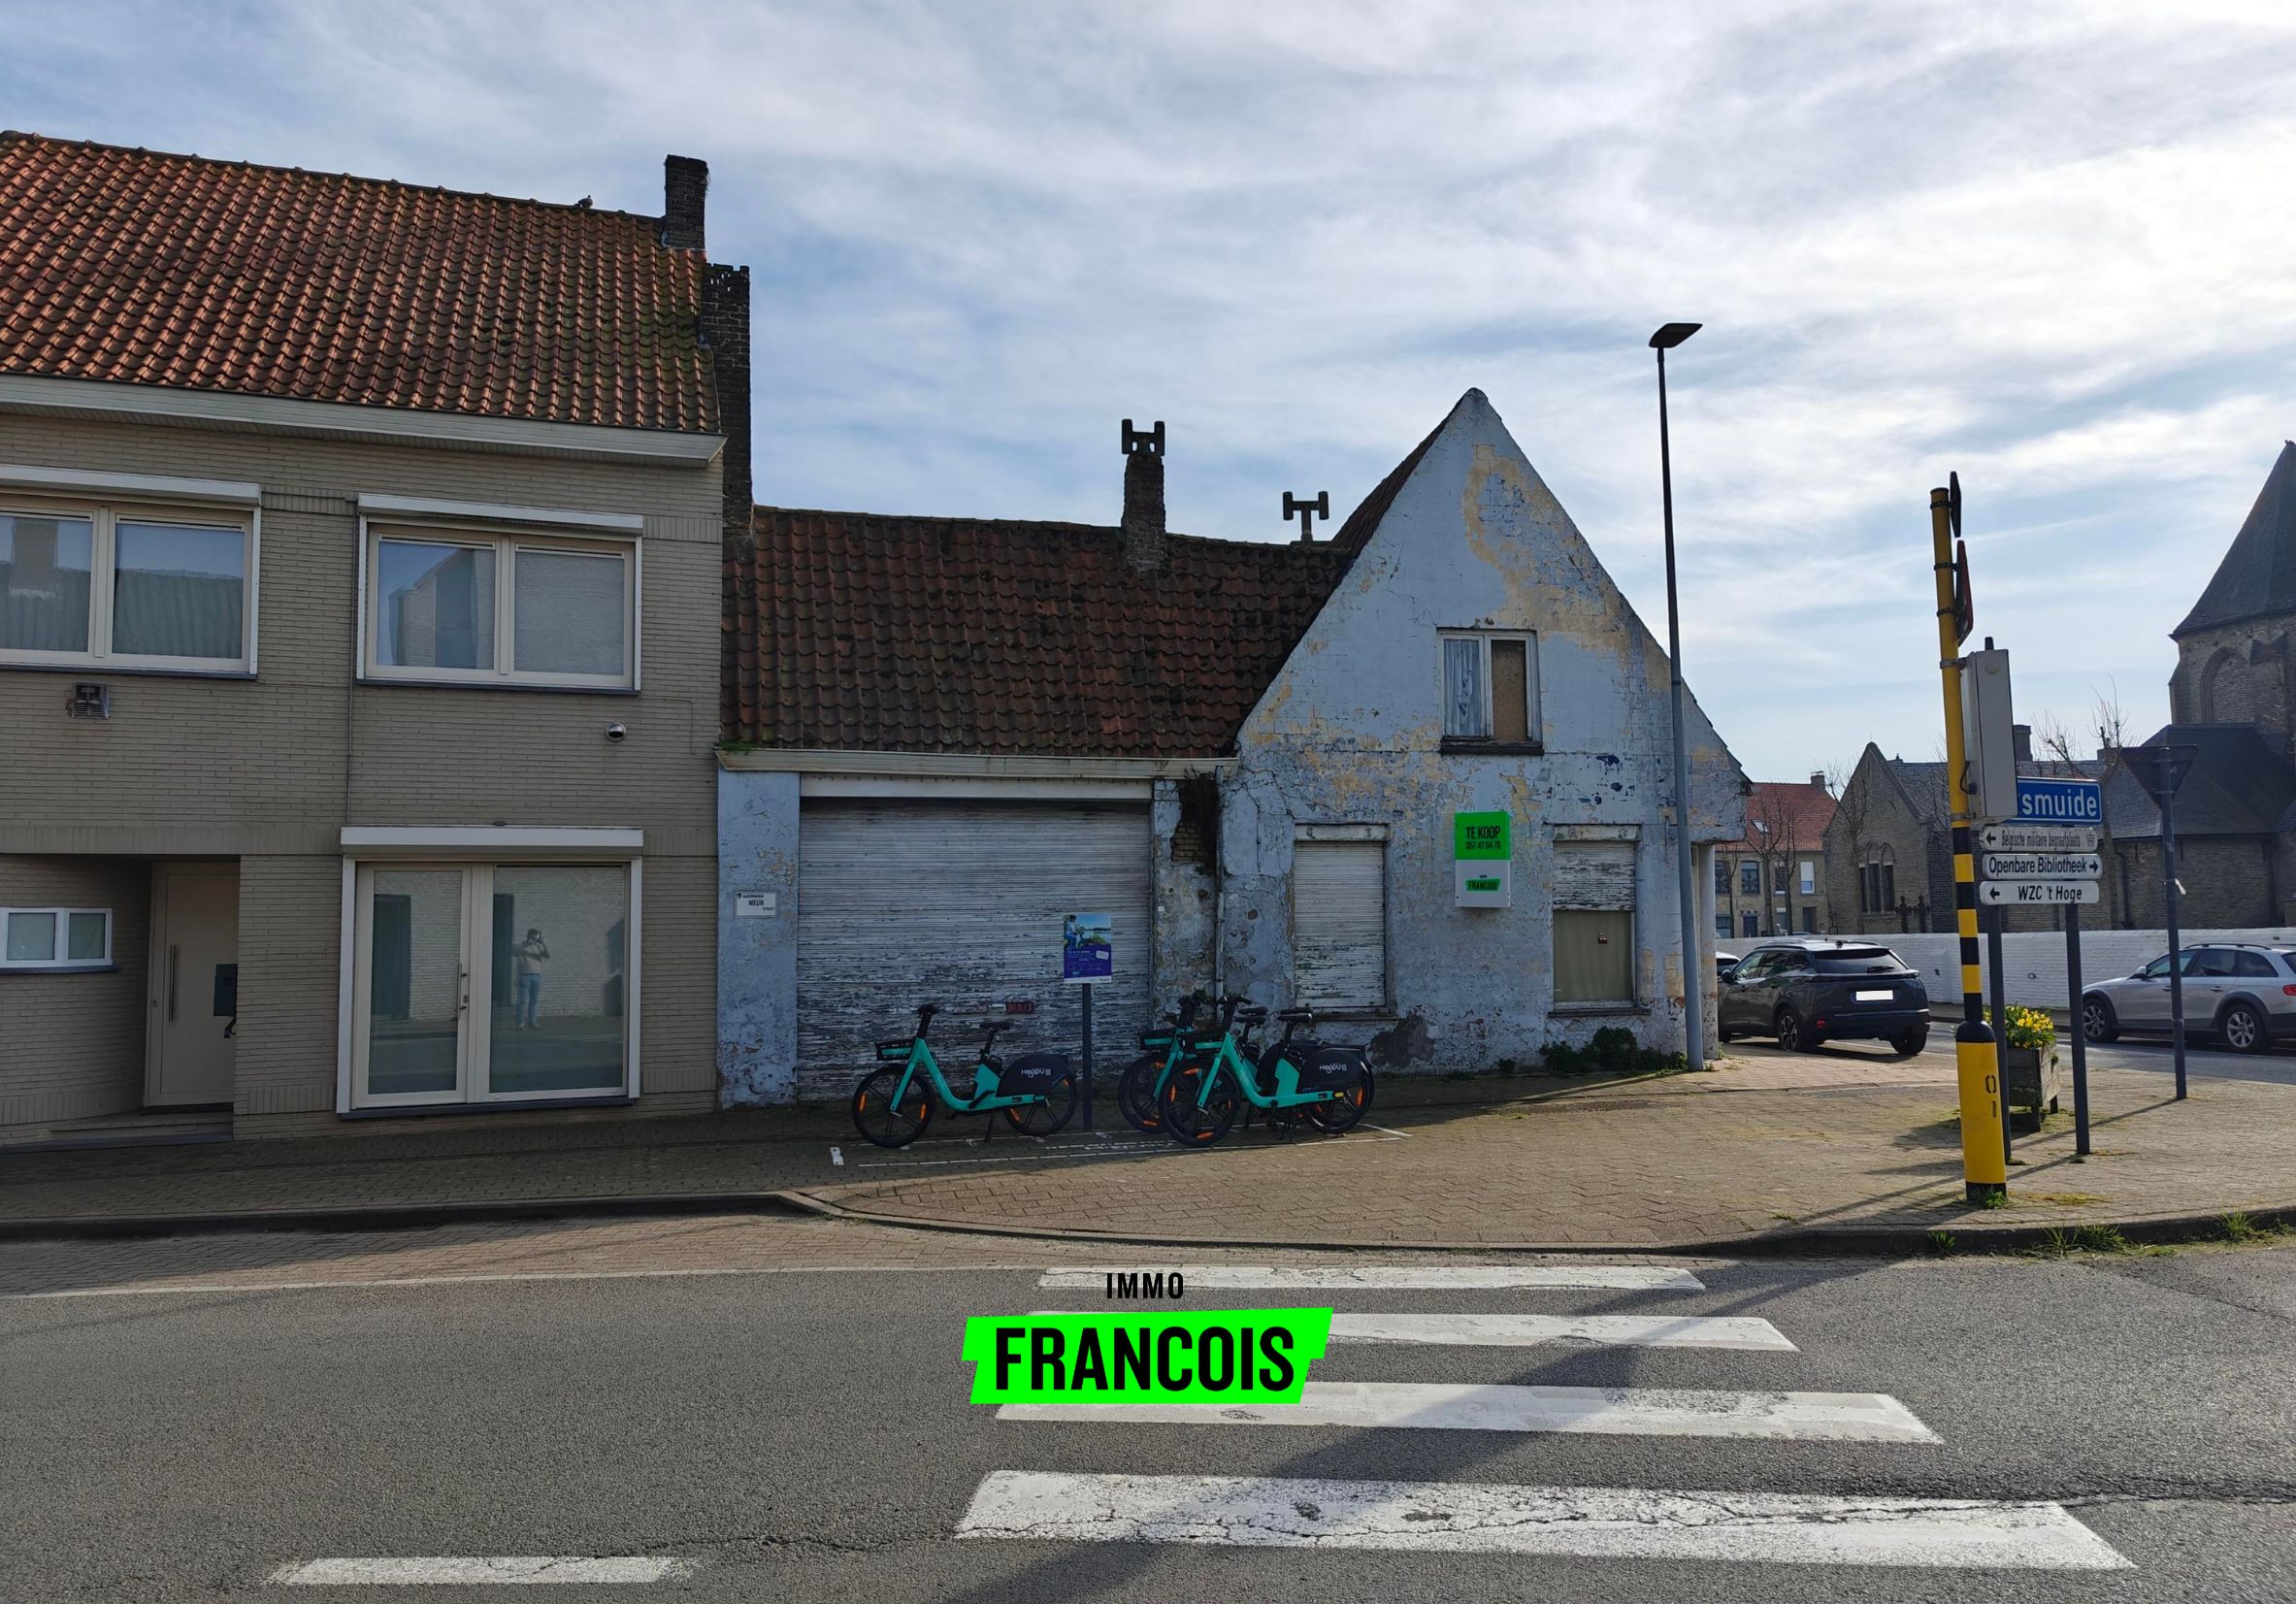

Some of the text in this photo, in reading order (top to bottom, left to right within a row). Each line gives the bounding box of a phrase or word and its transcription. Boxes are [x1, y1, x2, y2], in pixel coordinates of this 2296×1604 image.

[2019, 788, 2098, 817] smuide
[1465, 826, 1500, 839] TE KOOP
[2001, 831, 2025, 850] Belgische
[1988, 856, 2087, 877] Openbare Bibliotheek
[2017, 885, 2043, 900] WZC
[2055, 885, 2083, 903] Hoge
